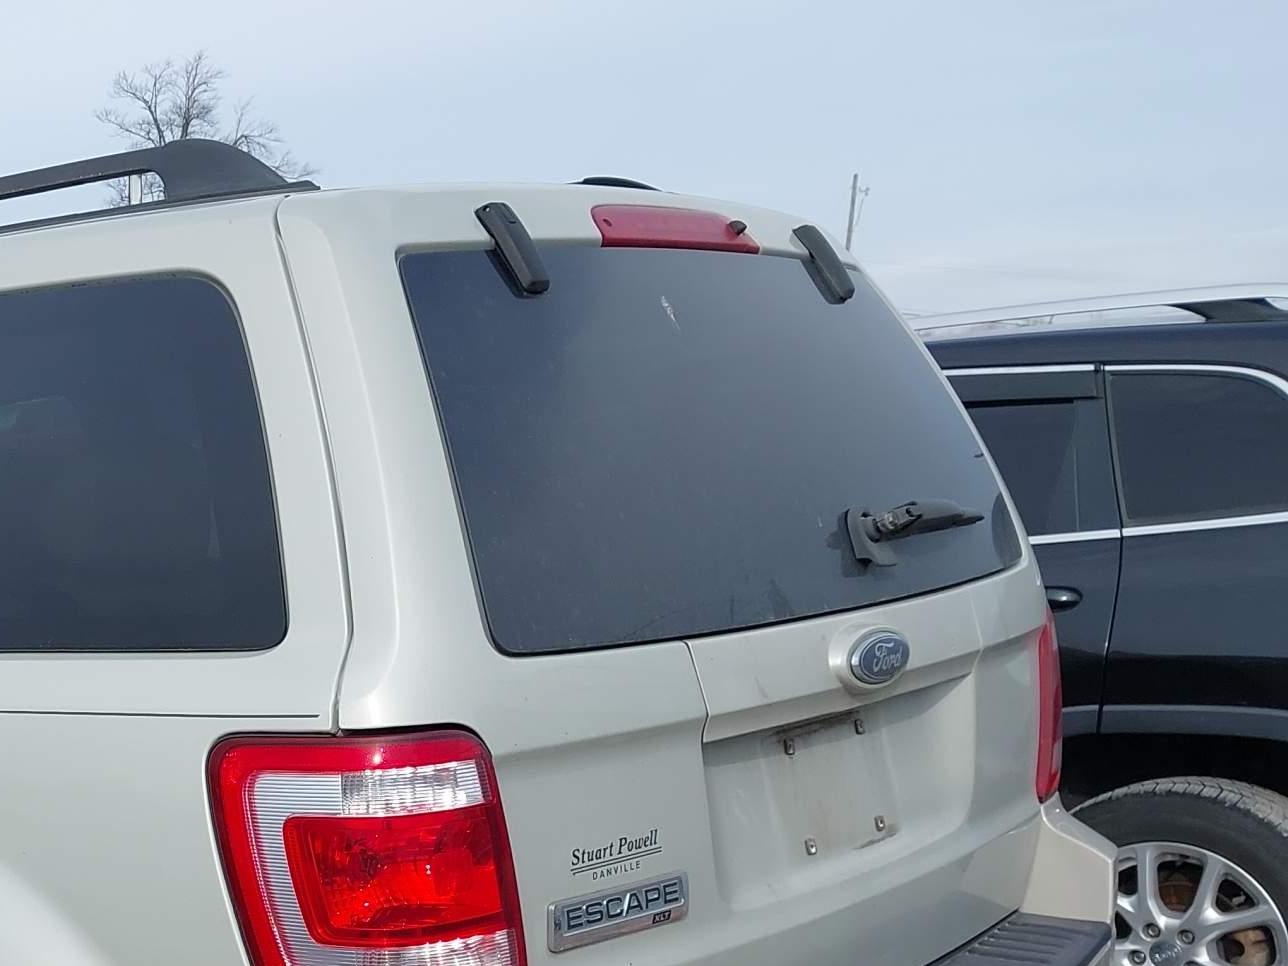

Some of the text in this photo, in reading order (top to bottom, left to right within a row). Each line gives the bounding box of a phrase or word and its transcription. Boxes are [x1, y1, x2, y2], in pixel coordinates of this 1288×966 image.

[873, 642, 903, 673] Ford
[571, 828, 658, 866] Stuart Powell
[592, 861, 641, 881] DANVILLE
[566, 881, 679, 931] ESCAPE
